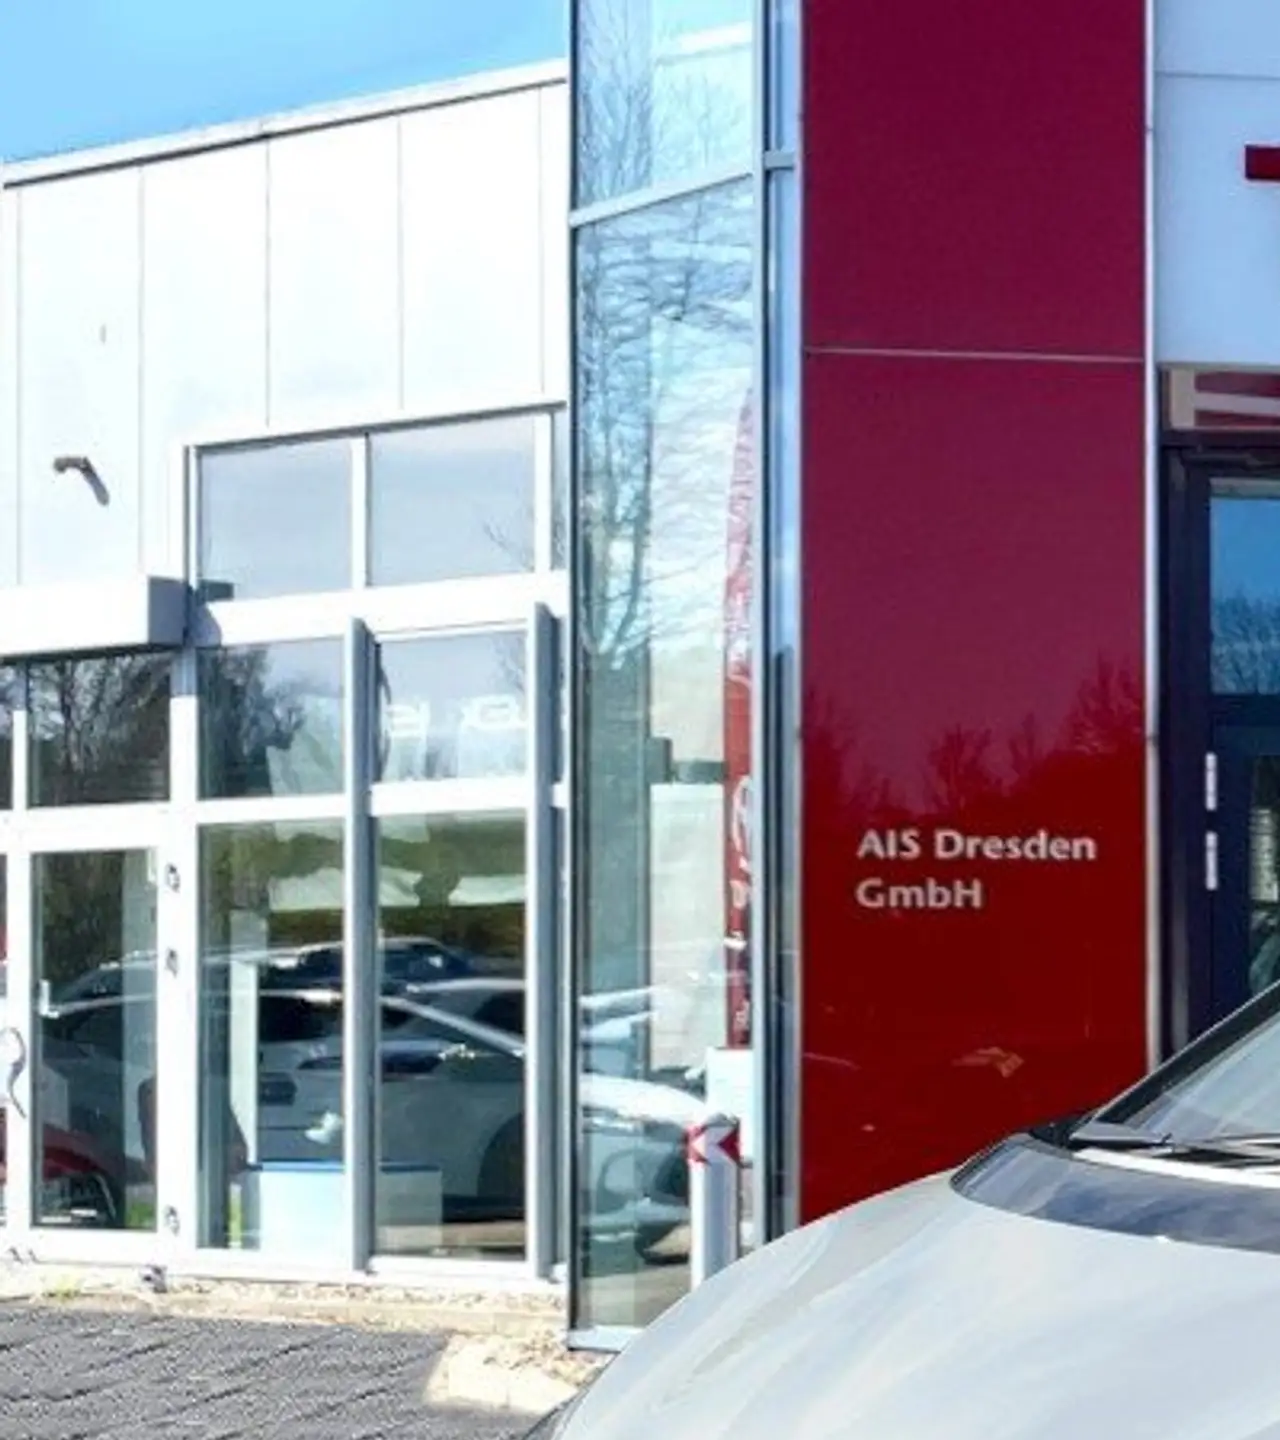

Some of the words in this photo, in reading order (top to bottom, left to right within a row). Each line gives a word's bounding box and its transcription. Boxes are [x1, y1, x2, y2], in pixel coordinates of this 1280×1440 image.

[857, 828, 921, 860] AIS
[933, 828, 1097, 861] Dresden
[854, 877, 984, 909] GmbH
